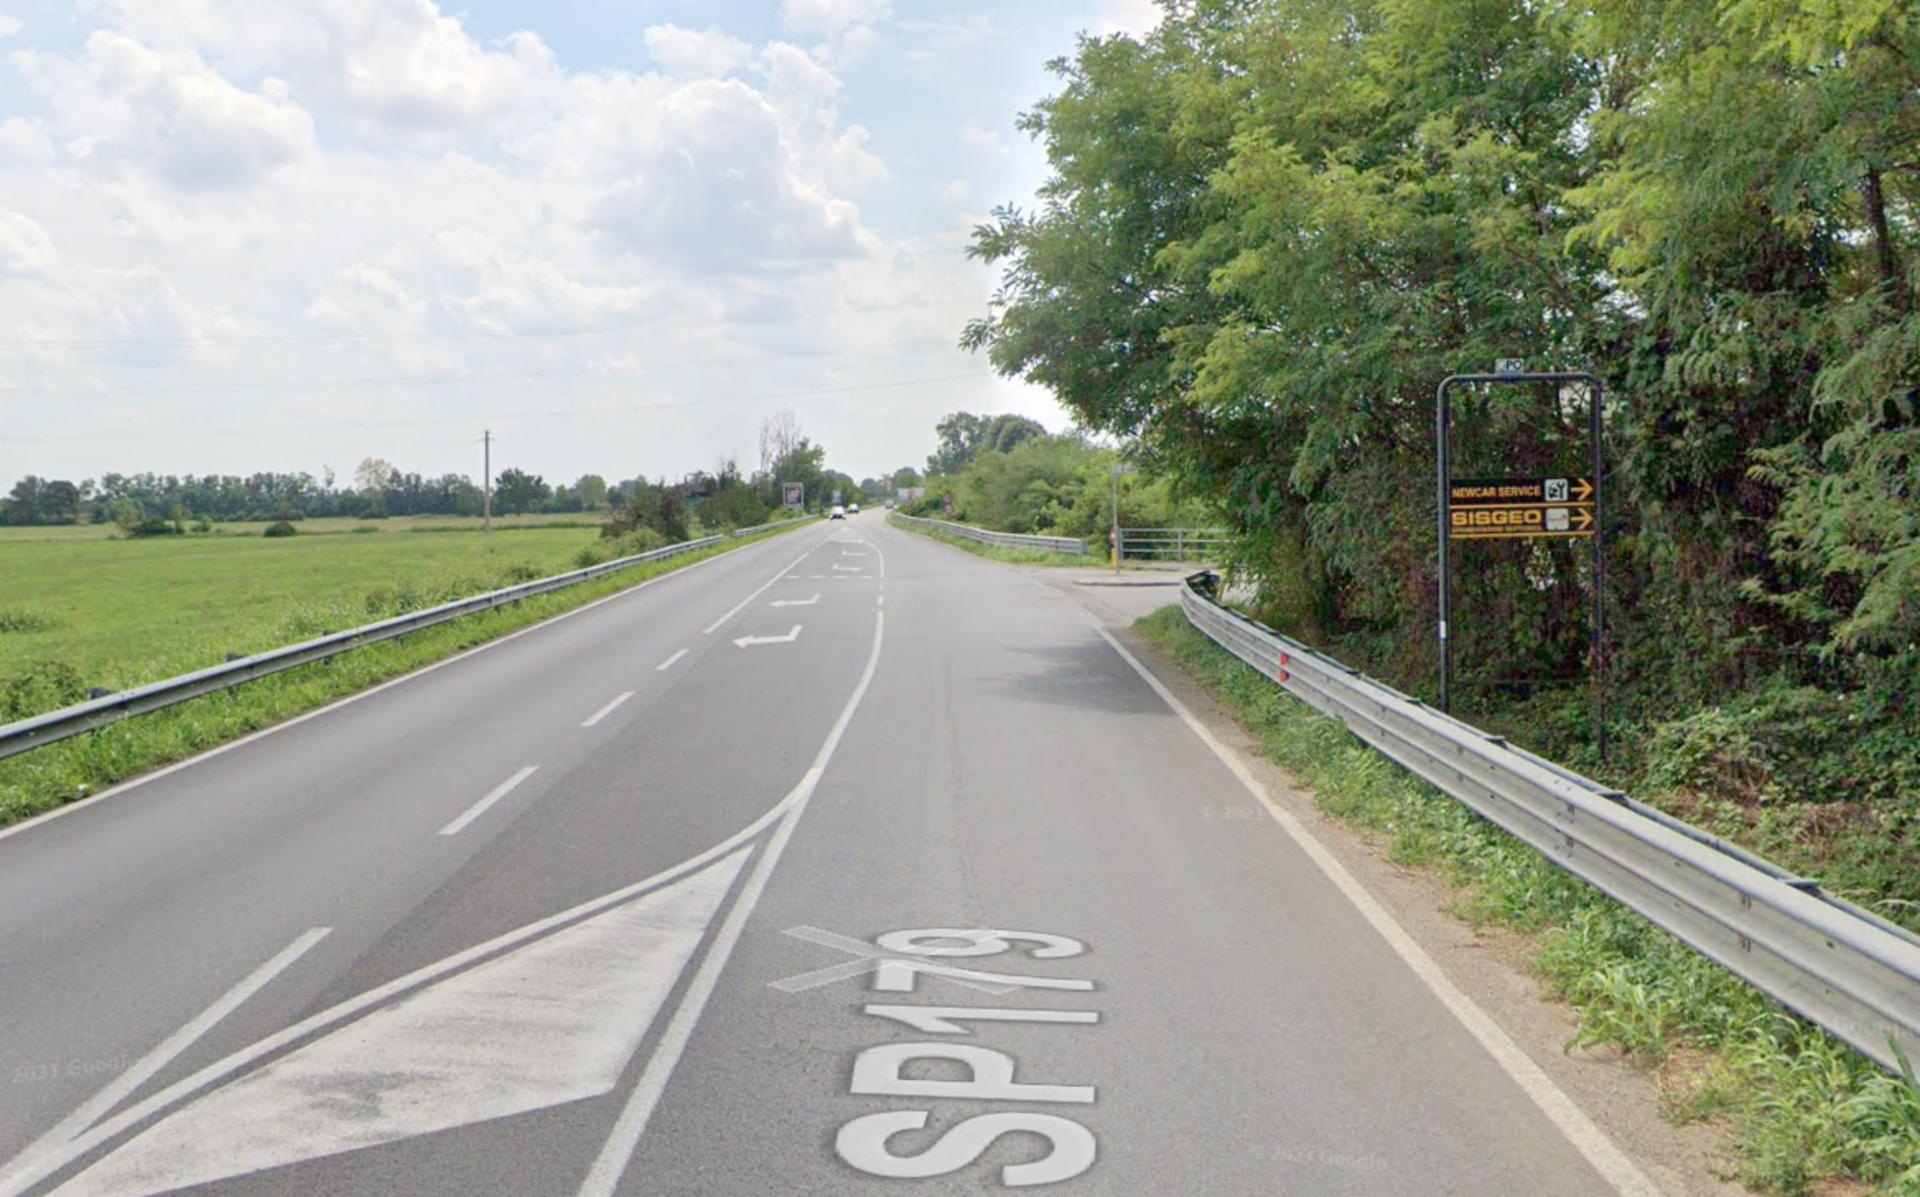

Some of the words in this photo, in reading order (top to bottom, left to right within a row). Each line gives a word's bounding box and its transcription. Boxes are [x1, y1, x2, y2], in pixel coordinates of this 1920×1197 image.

[1452, 487, 1496, 498] NEWCAR
[1498, 485, 1541, 497] SERVICE
[1452, 511, 1542, 525] SISGEO
